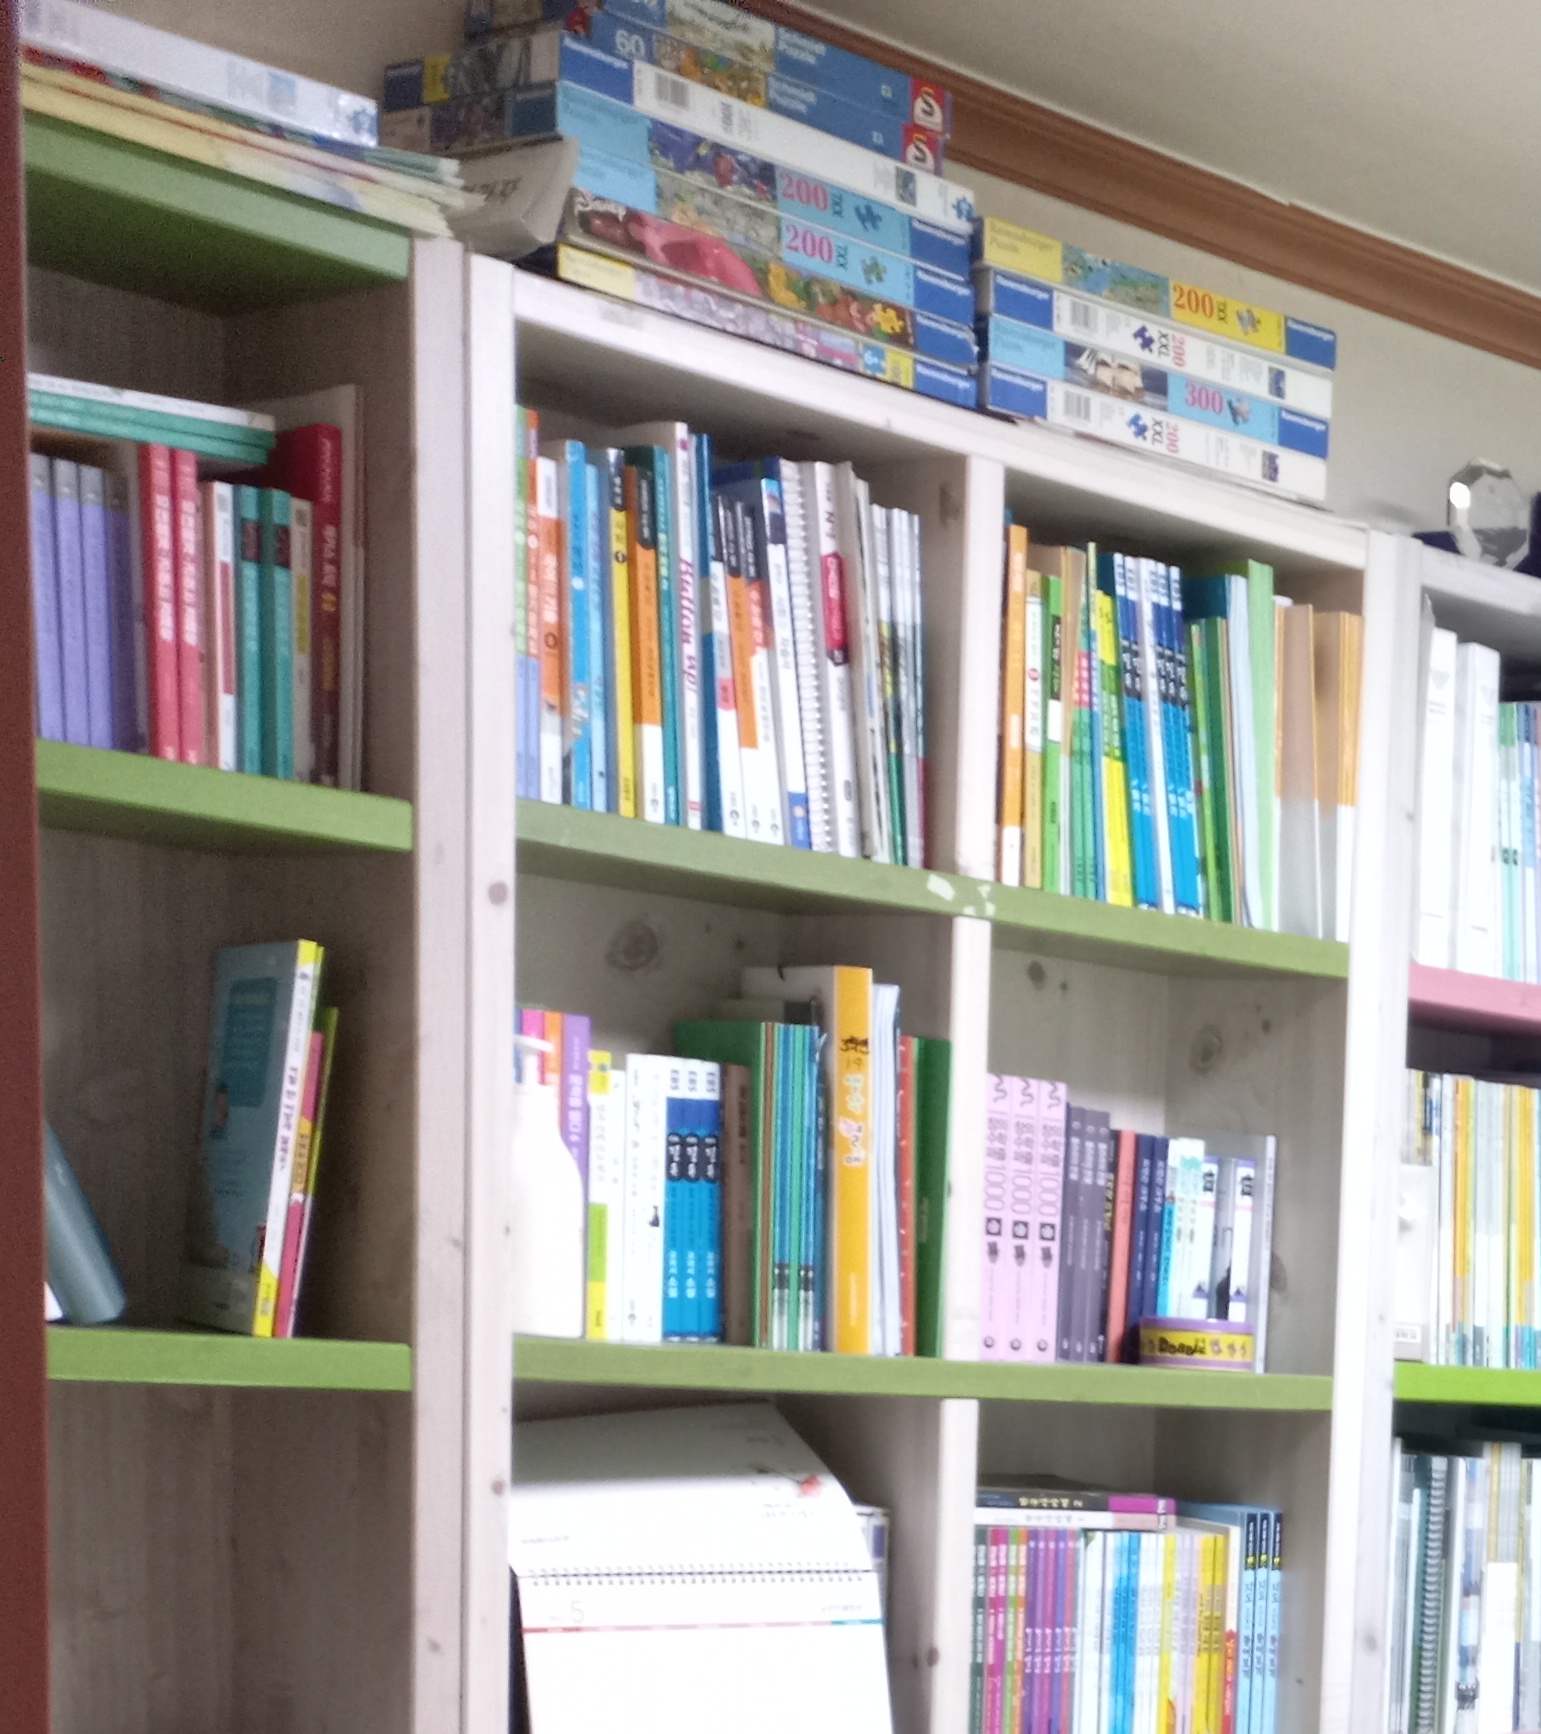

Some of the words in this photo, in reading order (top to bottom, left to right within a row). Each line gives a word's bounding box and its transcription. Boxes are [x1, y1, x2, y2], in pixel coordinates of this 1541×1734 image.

[781, 171, 830, 211] 200
[786, 224, 835, 264] 200
[1174, 284, 1215, 319] 200
[1185, 380, 1225, 415] 300
